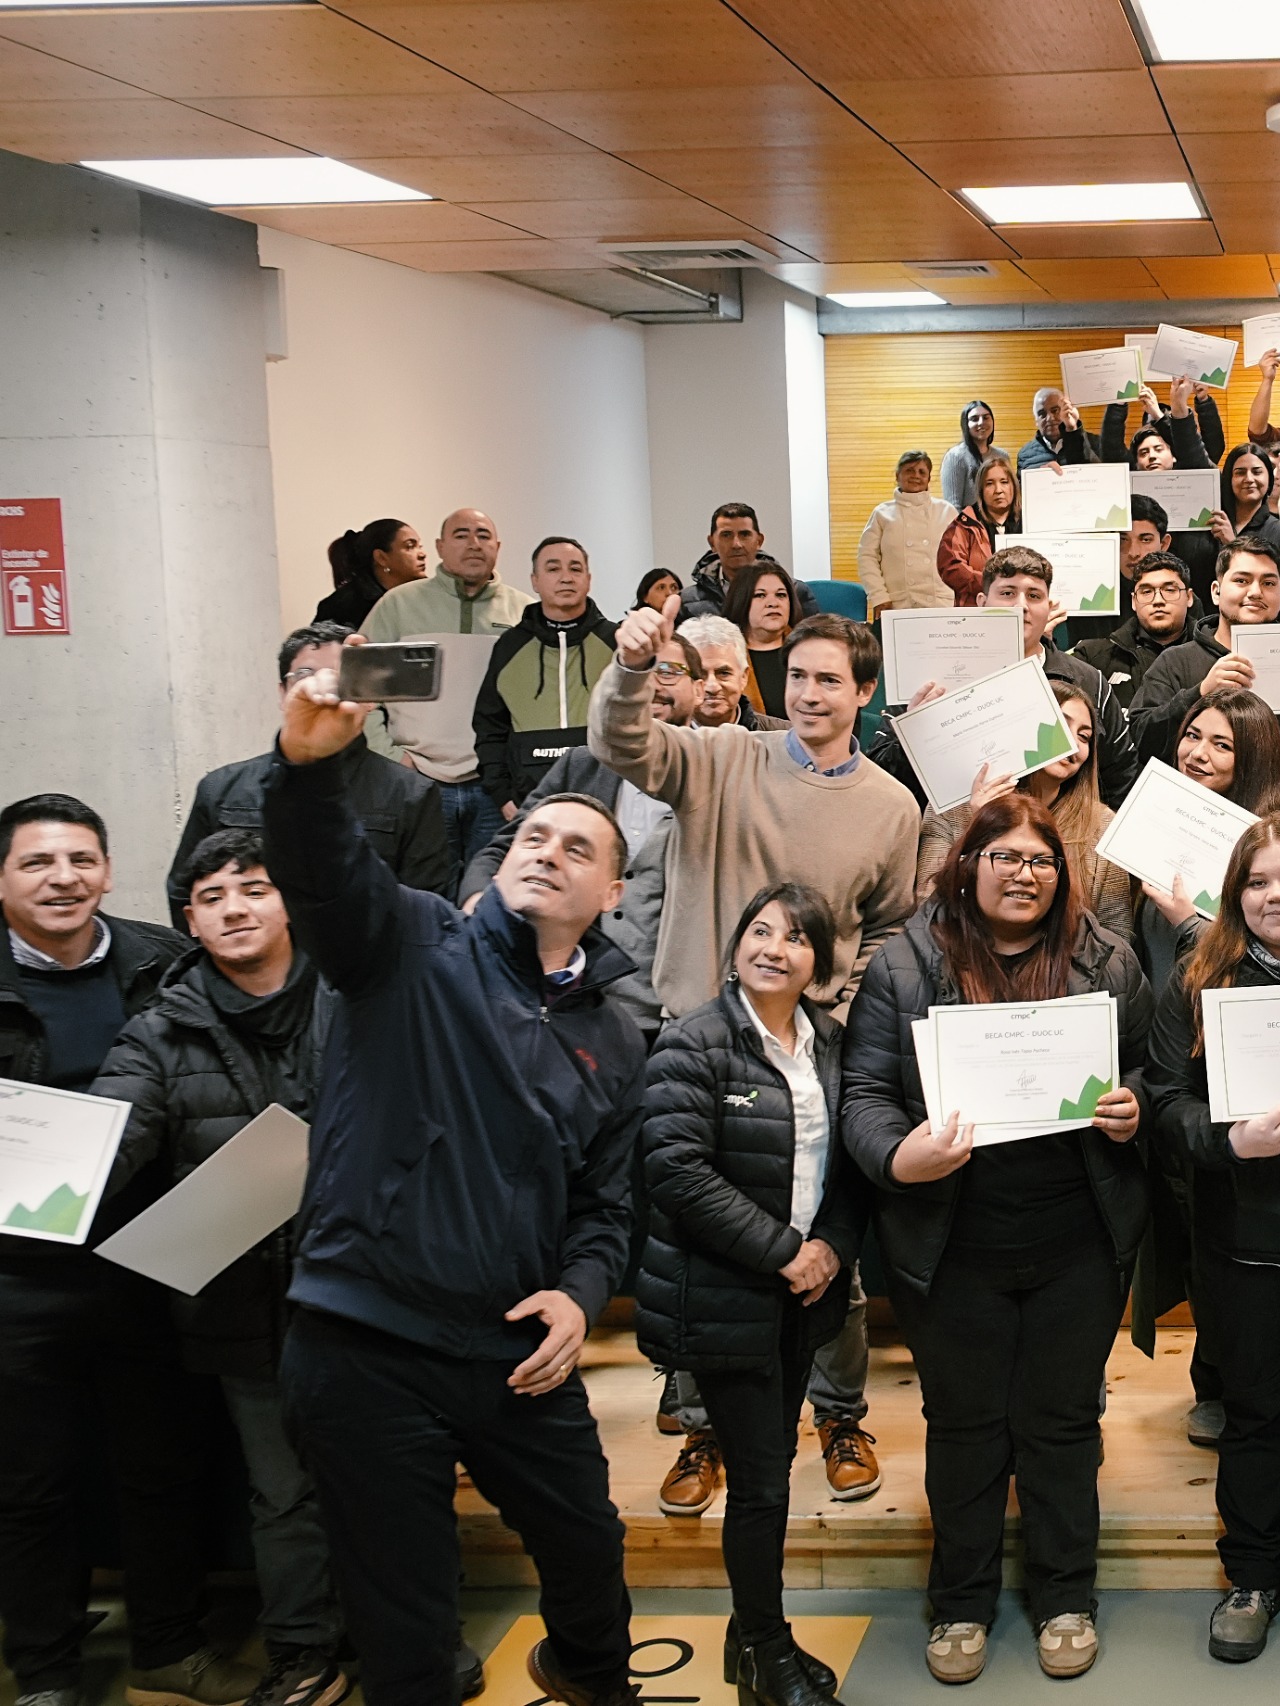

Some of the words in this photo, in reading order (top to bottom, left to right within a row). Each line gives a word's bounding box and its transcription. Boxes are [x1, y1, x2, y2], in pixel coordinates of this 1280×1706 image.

[941, 718, 956, 728] BECA
[956, 710, 972, 720] CMPC
[977, 701, 994, 712] DUOC
